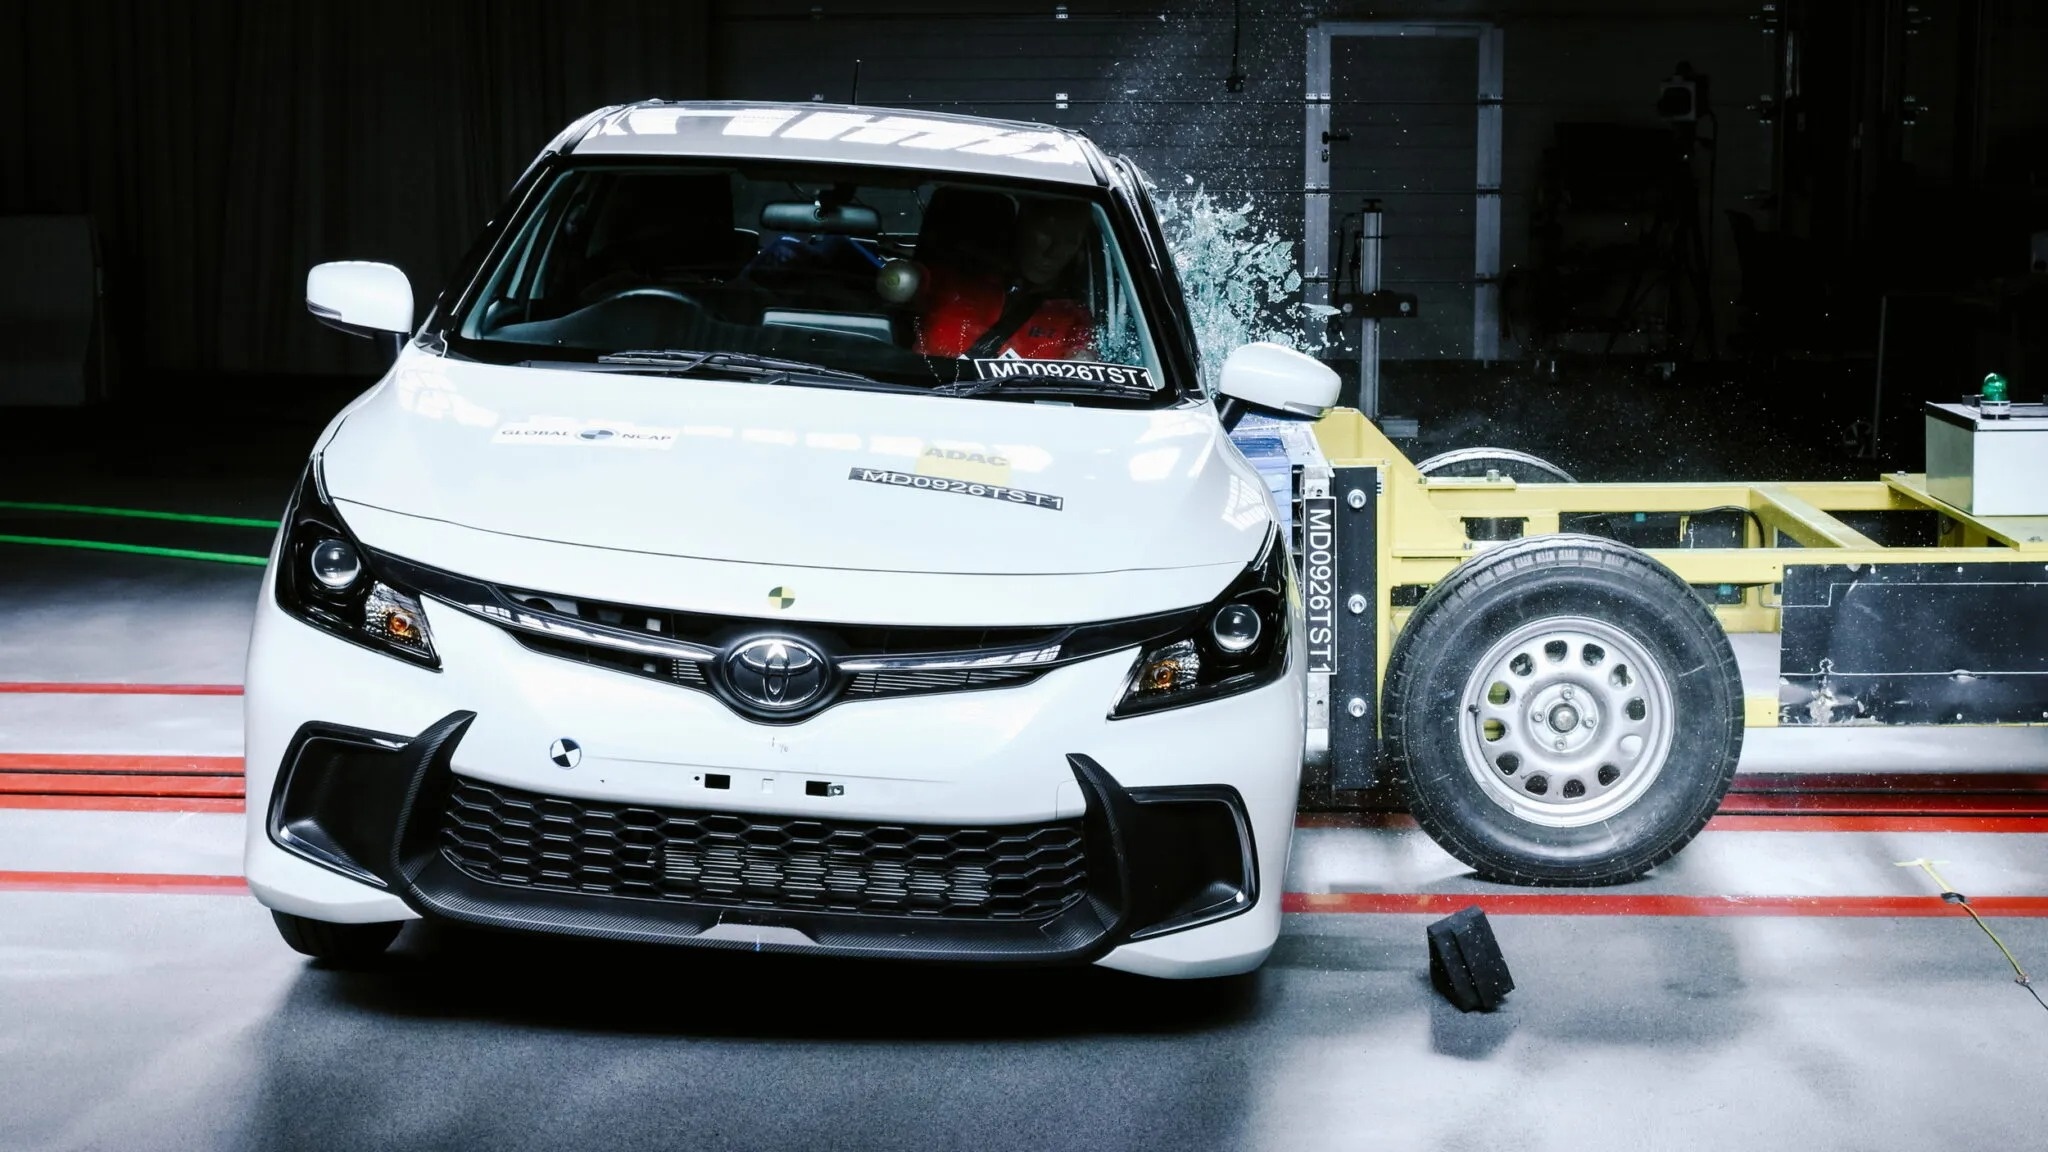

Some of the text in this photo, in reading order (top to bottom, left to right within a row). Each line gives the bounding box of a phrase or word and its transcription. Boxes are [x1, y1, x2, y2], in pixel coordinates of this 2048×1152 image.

[989, 362, 1153, 387] MD0926TST1
[622, 433, 671, 441] NCAP
[925, 447, 1009, 466] ADAC
[862, 469, 1062, 509] MD0926TST1
[1309, 508, 1332, 673] MD0926TST1
